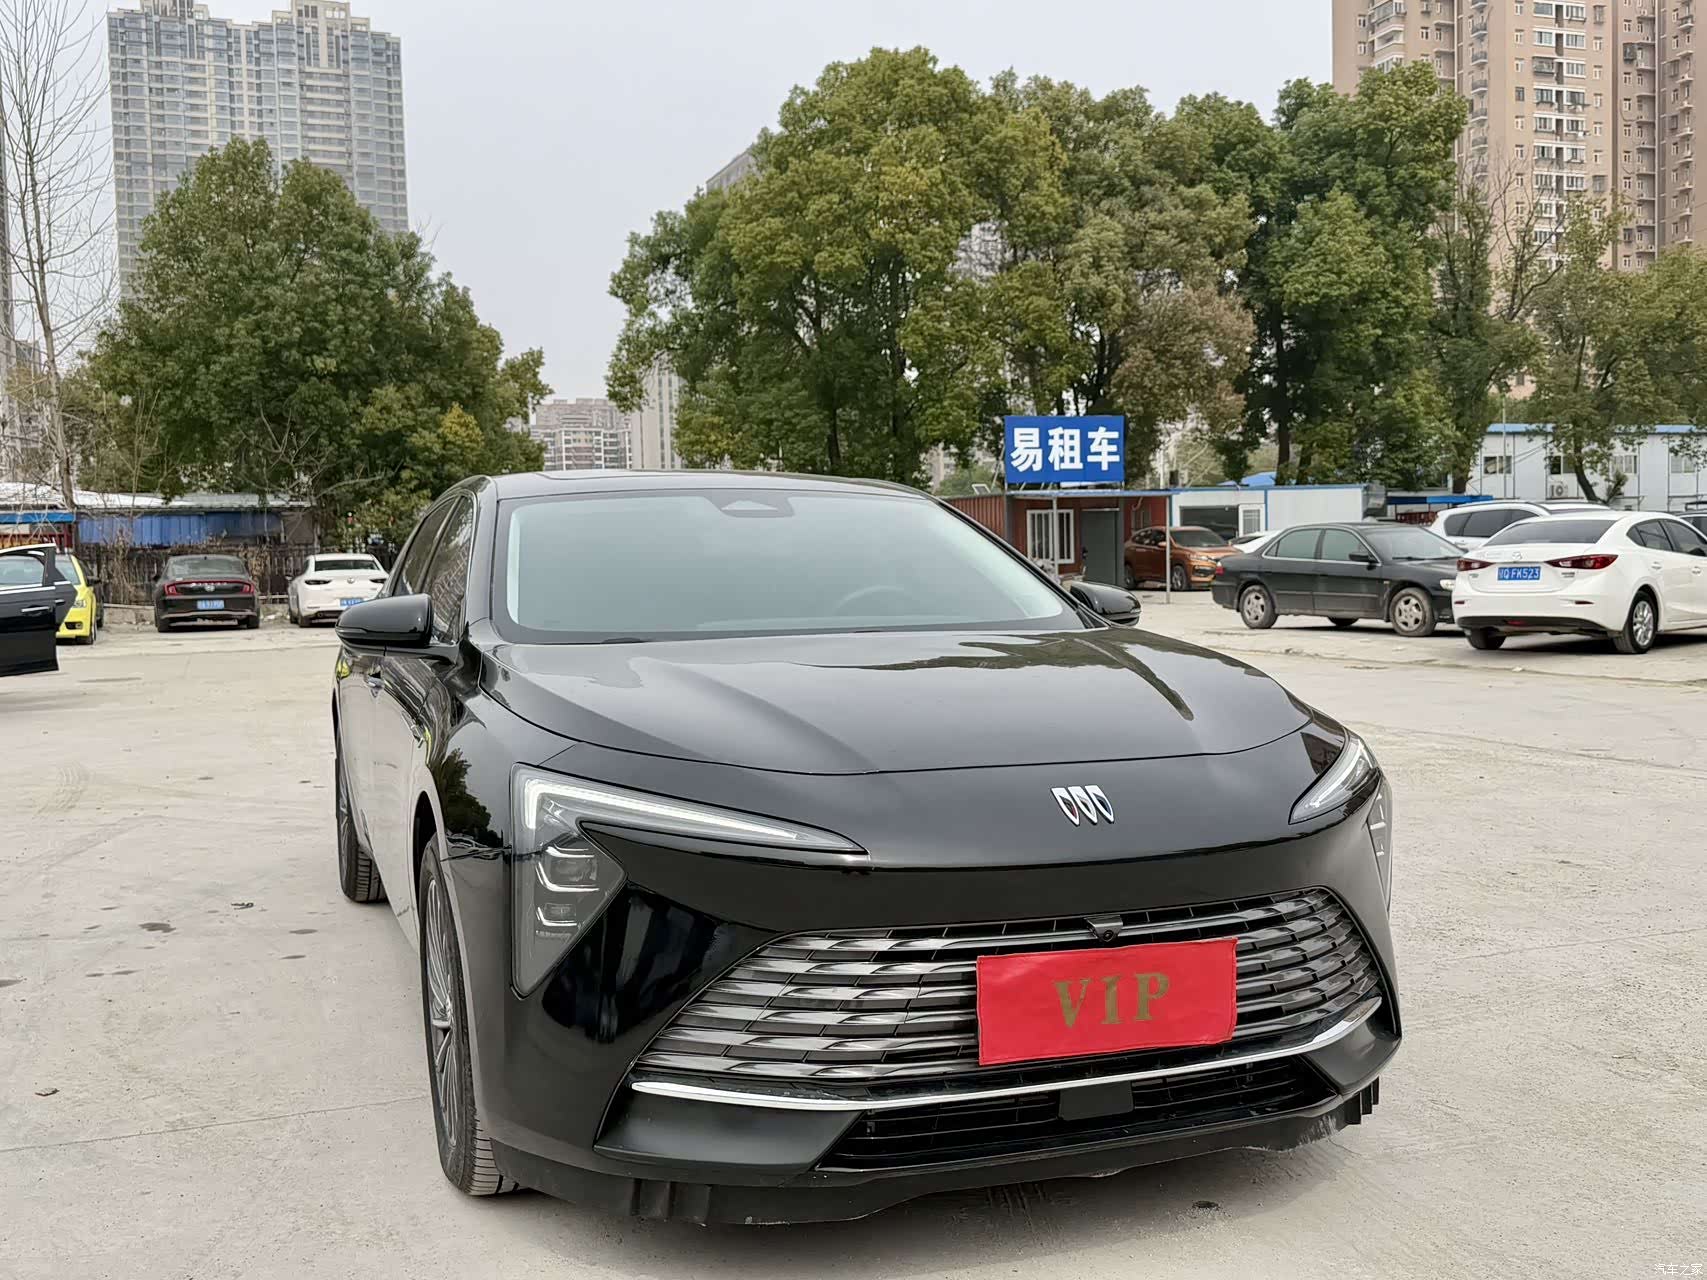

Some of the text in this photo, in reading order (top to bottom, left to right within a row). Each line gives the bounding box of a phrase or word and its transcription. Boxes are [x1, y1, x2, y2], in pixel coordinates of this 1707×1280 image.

[1010, 426, 1120, 472] 易租车
[1054, 972, 1169, 1028] VIP
